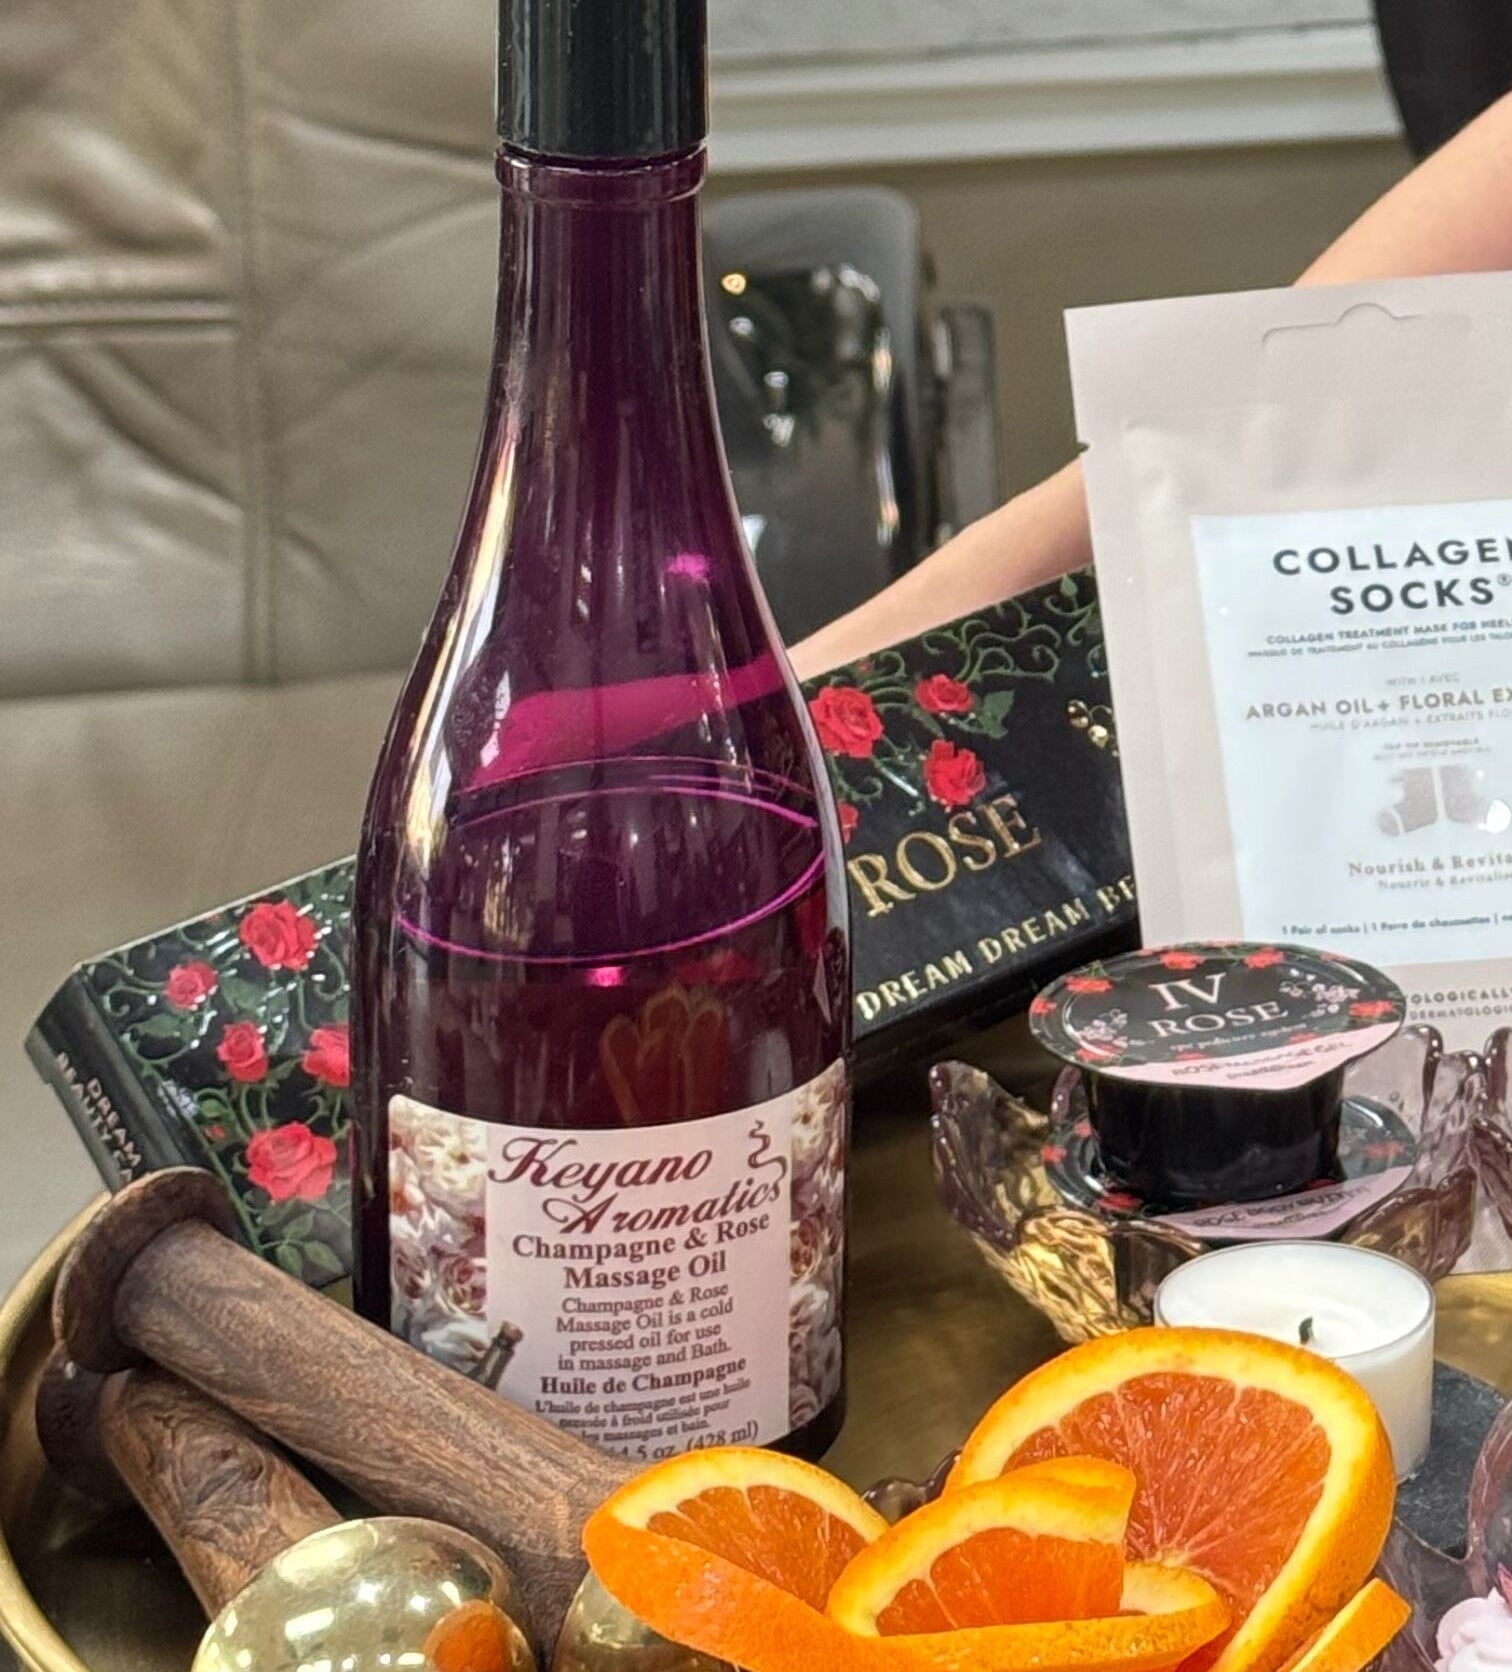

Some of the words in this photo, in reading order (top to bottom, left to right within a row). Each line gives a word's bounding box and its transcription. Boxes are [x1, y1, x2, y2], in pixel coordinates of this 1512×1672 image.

[1266, 630, 1333, 645] COLLAGEN
[1338, 625, 1410, 640] TREATMENT
[1414, 622, 1447, 636] MASK
[1452, 620, 1477, 632] FOR
[1246, 702, 1327, 720] ARGAN
[1335, 697, 1374, 715] OIL
[1377, 700, 1391, 712] +
[1400, 690, 1485, 710] FLORAL
[1427, 711, 1485, 724] EXTRAITS
[848, 793, 1042, 917] ROSE
[1347, 857, 1426, 878] Nourish
[1431, 856, 1446, 872] &
[856, 950, 973, 1021] DREAM
[977, 898, 1090, 964] DREAM
[1149, 972, 1228, 1011] IV
[1148, 1001, 1289, 1038] ROSE
[1195, 1032, 1256, 1051] pedicure
[1258, 1023, 1308, 1040] system
[87, 1077, 142, 1167] DREAM
[487, 1136, 713, 1202] Keyano
[542, 1177, 783, 1235] Aromatics
[512, 1234, 676, 1264] Champagne
[684, 1227, 708, 1249] &
[716, 1212, 770, 1243] Rose
[563, 1264, 681, 1290] Massage
[688, 1252, 727, 1278] Oil
[556, 1313, 632, 1335] Massage
[636, 1311, 664, 1330] Oil
[668, 1309, 684, 1326] is
[700, 1298, 734, 1321] cold
[561, 1293, 664, 1315] Champagne
[668, 1290, 686, 1306] &
[690, 1282, 729, 1302] Rose
[557, 1355, 575, 1371] in
[579, 1353, 652, 1374] massage
[656, 1347, 688, 1366] and
[690, 1341, 732, 1362] Bath.
[569, 1335, 635, 1356] pressed
[639, 1331, 662, 1348] oil
[666, 1327, 692, 1346] for
[695, 1325, 722, 1341] use
[540, 1375, 596, 1395] Huile
[602, 1375, 627, 1393] de
[631, 1356, 746, 1392] Champagne
[584, 1401, 600, 1413] de
[603, 1396, 676, 1414] champagne
[679, 1393, 697, 1404] est
[723, 1377, 752, 1394] huile
[621, 1410, 653, 1427] froid
[703, 1399, 730, 1417] pour
[666, 1424, 679, 1435] et
[731, 1419, 759, 1443] ml)
